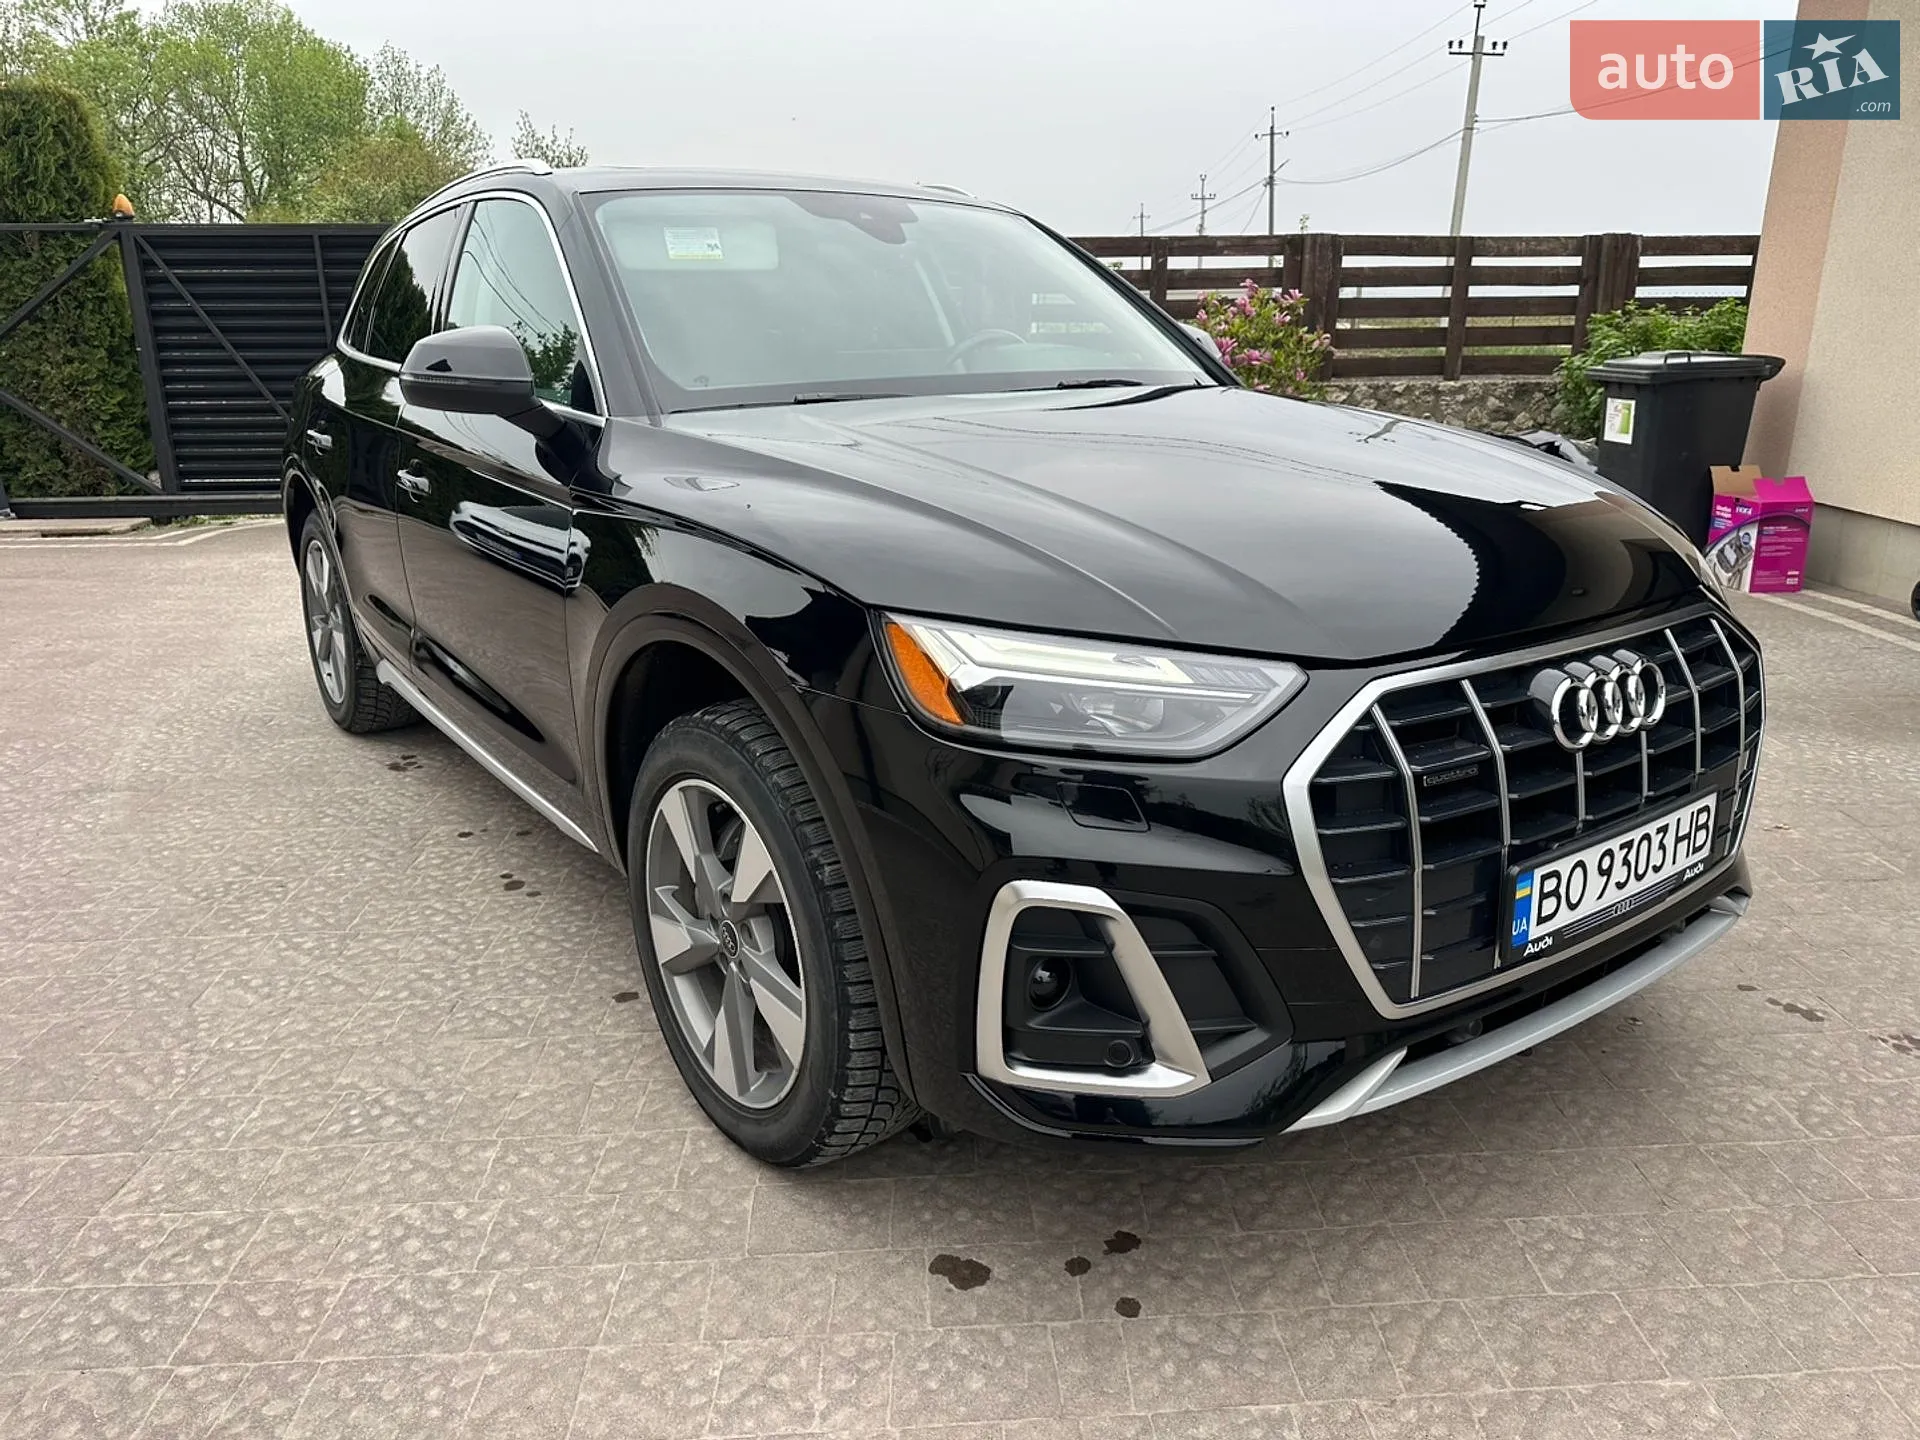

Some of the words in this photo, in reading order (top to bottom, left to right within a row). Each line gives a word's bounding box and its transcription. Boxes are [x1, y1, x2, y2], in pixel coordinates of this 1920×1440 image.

[1536, 859, 1588, 927] BO
[1596, 822, 1670, 901] 9303
[1672, 804, 1711, 866] HB
[1682, 862, 1705, 881] Audi
[1511, 916, 1528, 936] UA
[1523, 936, 1553, 957] Audi
